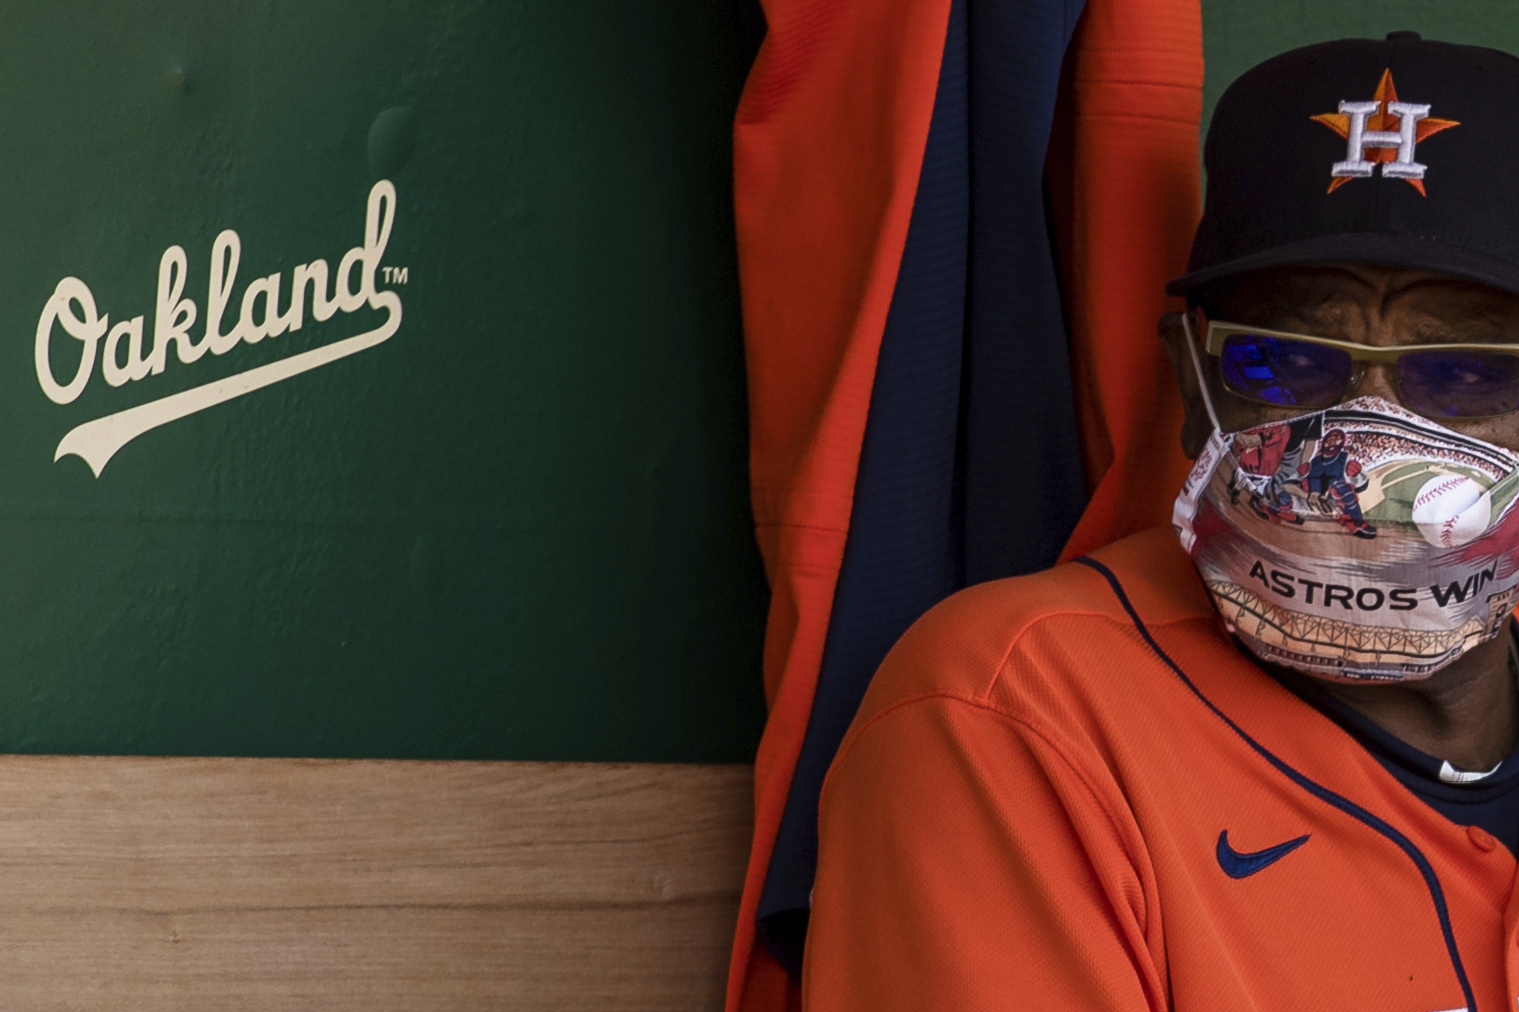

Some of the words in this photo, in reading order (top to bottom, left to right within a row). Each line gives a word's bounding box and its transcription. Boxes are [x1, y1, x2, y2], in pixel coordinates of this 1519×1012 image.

[1332, 100, 1431, 179] H
[35, 179, 402, 405] Oakland
[1249, 560, 1418, 611] ASTROS
[1430, 560, 1498, 608] WIN
